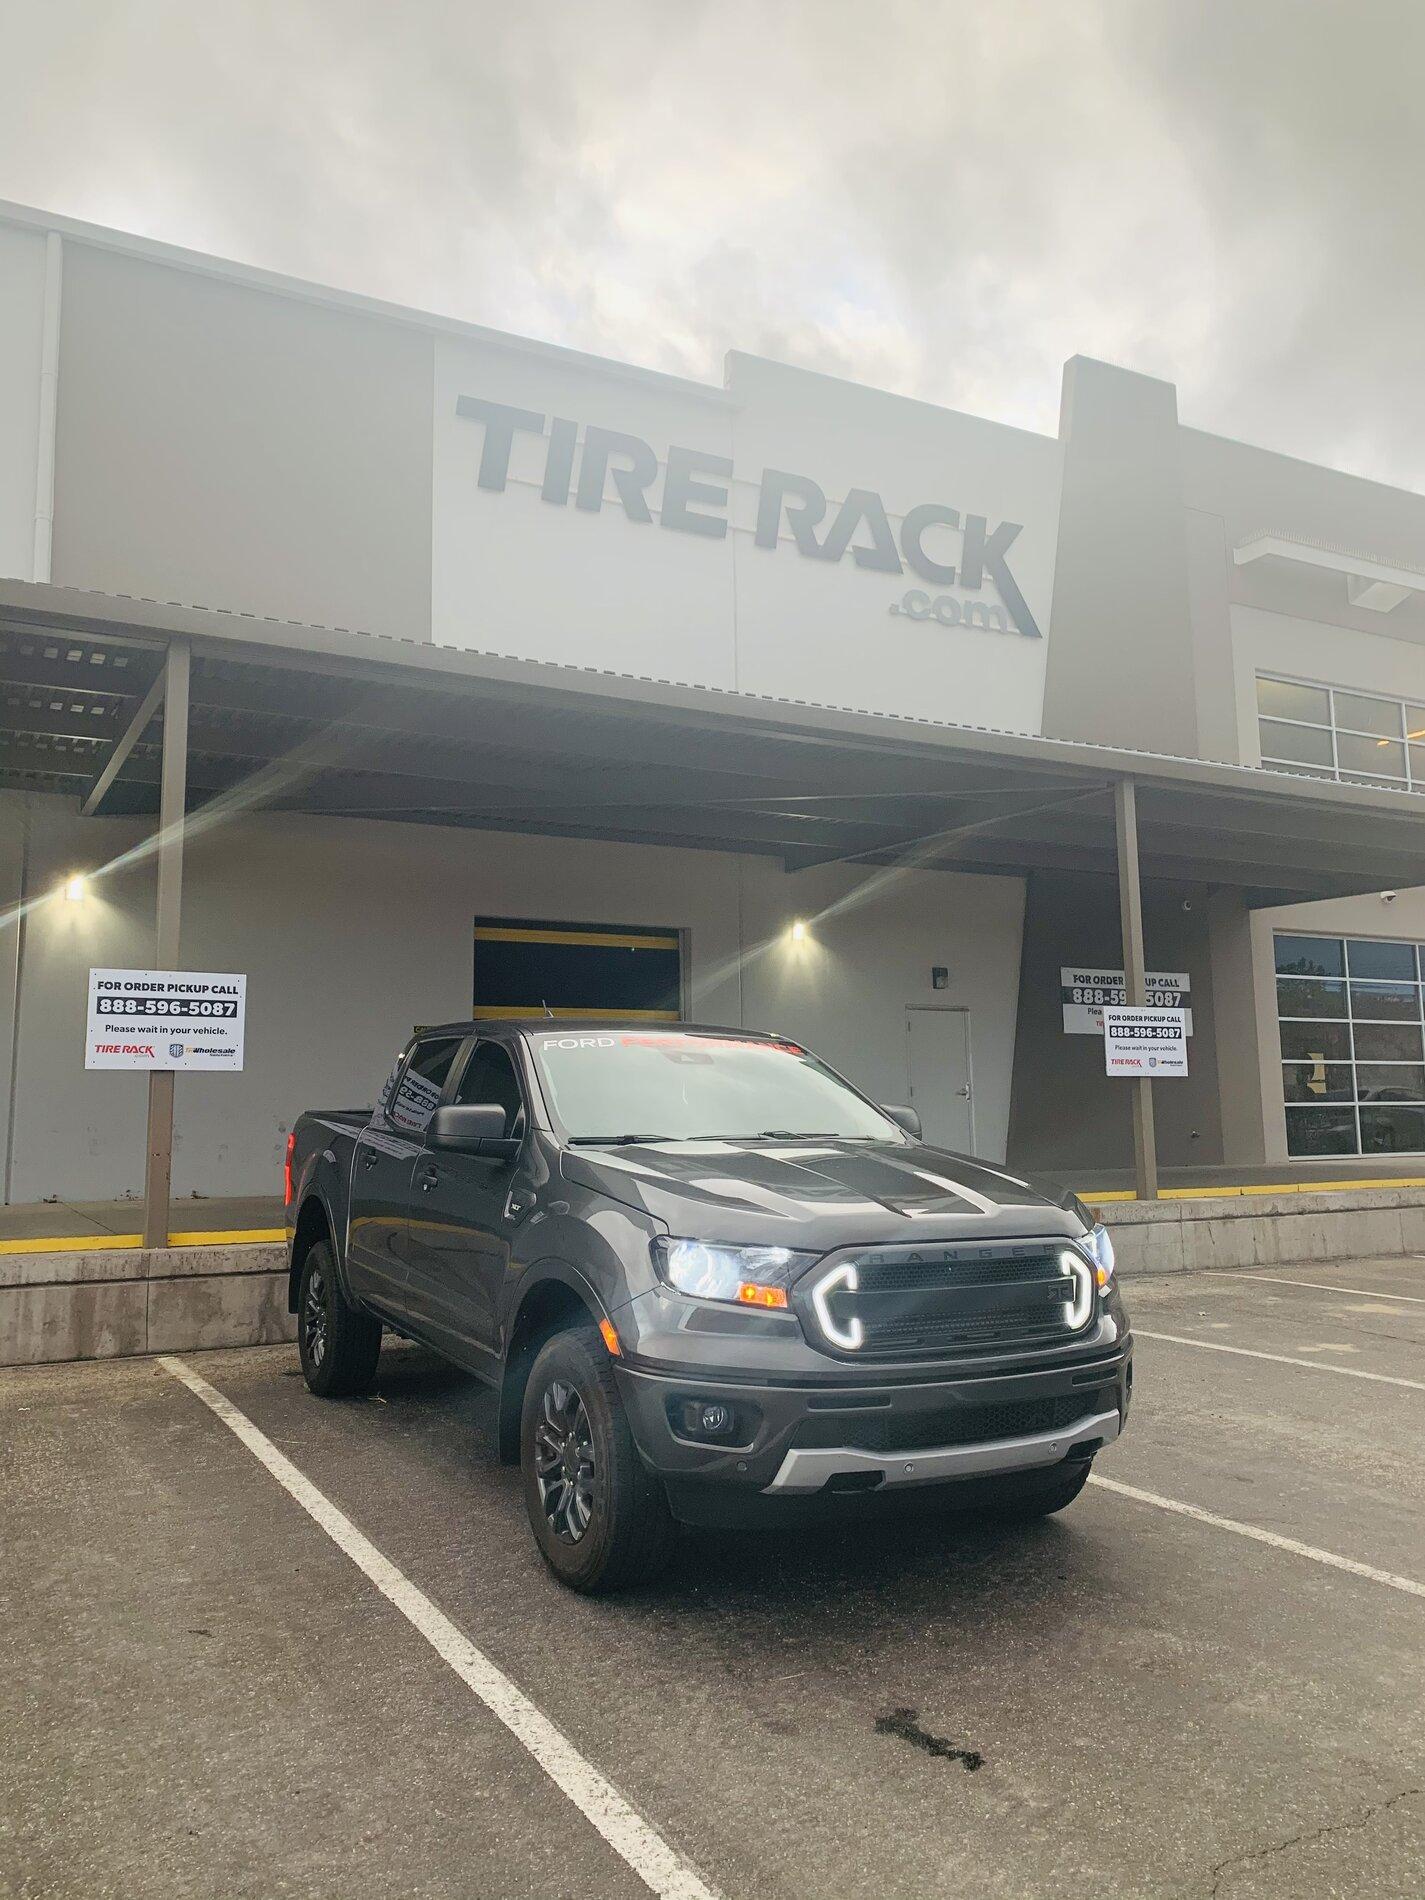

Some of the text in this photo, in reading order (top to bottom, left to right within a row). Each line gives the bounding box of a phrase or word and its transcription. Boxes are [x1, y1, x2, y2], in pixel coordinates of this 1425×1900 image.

[455, 394, 1043, 638] TIRE RACK
[889, 588, 1010, 634] .com
[97, 980, 239, 995] FOR ORDER PICKUP CALL
[1073, 974, 1091, 984] FOR
[1094, 975, 1124, 985] ORDER
[1158, 979, 1180, 987] CALL
[1072, 988, 1181, 1007] 888-595087
[100, 998, 236, 1016] 888-596-5087
[1087, 1007, 1103, 1015] Plea
[105, 1024, 228, 1036] Please wait in your vehicle.
[1110, 1027, 1181, 1038] 888-596-5087
[95, 1044, 121, 1053] TIRE
[122, 1045, 155, 1058] RACK
[543, 1037, 615, 1051] FORD
[869, 1244, 1057, 1263] RANGER
